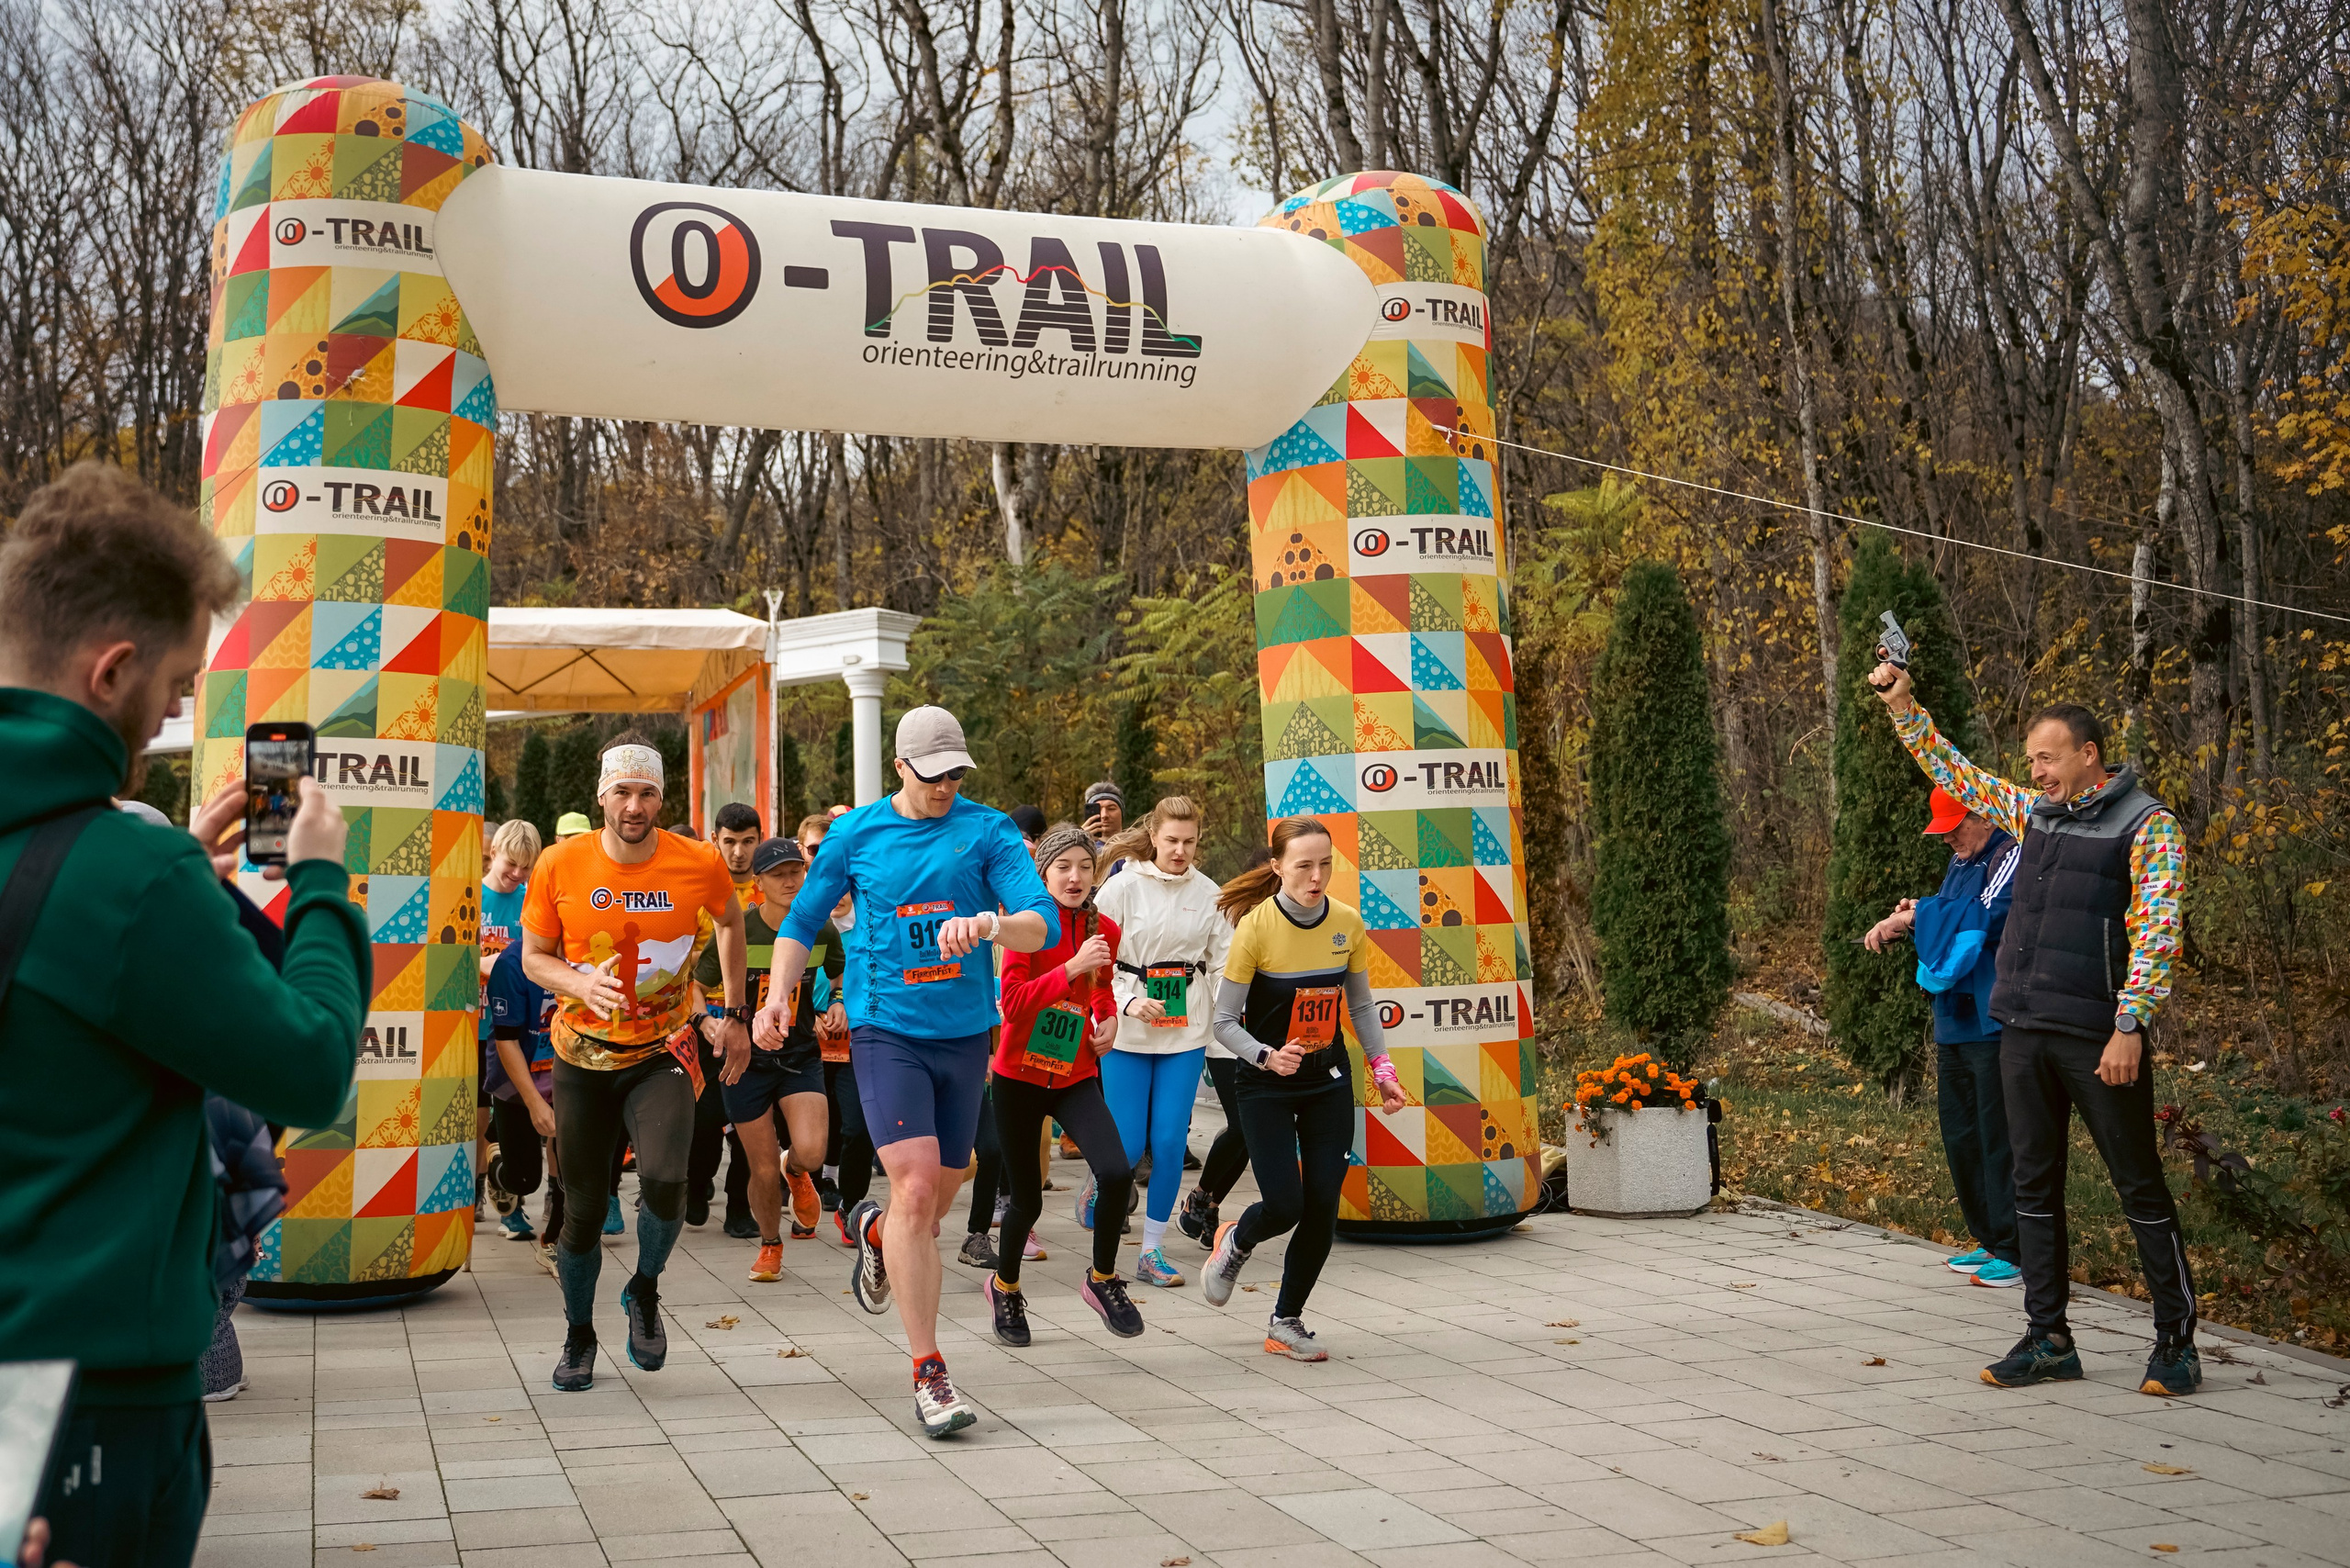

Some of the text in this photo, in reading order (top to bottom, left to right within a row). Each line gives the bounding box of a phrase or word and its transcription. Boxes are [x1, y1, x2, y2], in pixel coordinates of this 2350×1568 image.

[334, 243, 433, 260] orienteering&trailrunning
[1431, 320, 1484, 336] orienteering&trailrunning
[862, 341, 1197, 388] orienteering&trailrunning
[331, 511, 442, 530] orienteering&trailrunning
[1419, 553, 1494, 565] orienteering&trailrunning
[313, 752, 430, 788] TRAIL
[317, 783, 429, 795] orienteering&trailrunning
[1427, 787, 1506, 796] orienteering&trailrunning
[1153, 980, 1181, 1000] 314
[1297, 999, 1334, 1023] 1317
[1040, 1011, 1079, 1043] 301
[1434, 1021, 1516, 1034] orienteering&trailrunning
[354, 1056, 417, 1066] g&trailrunning
